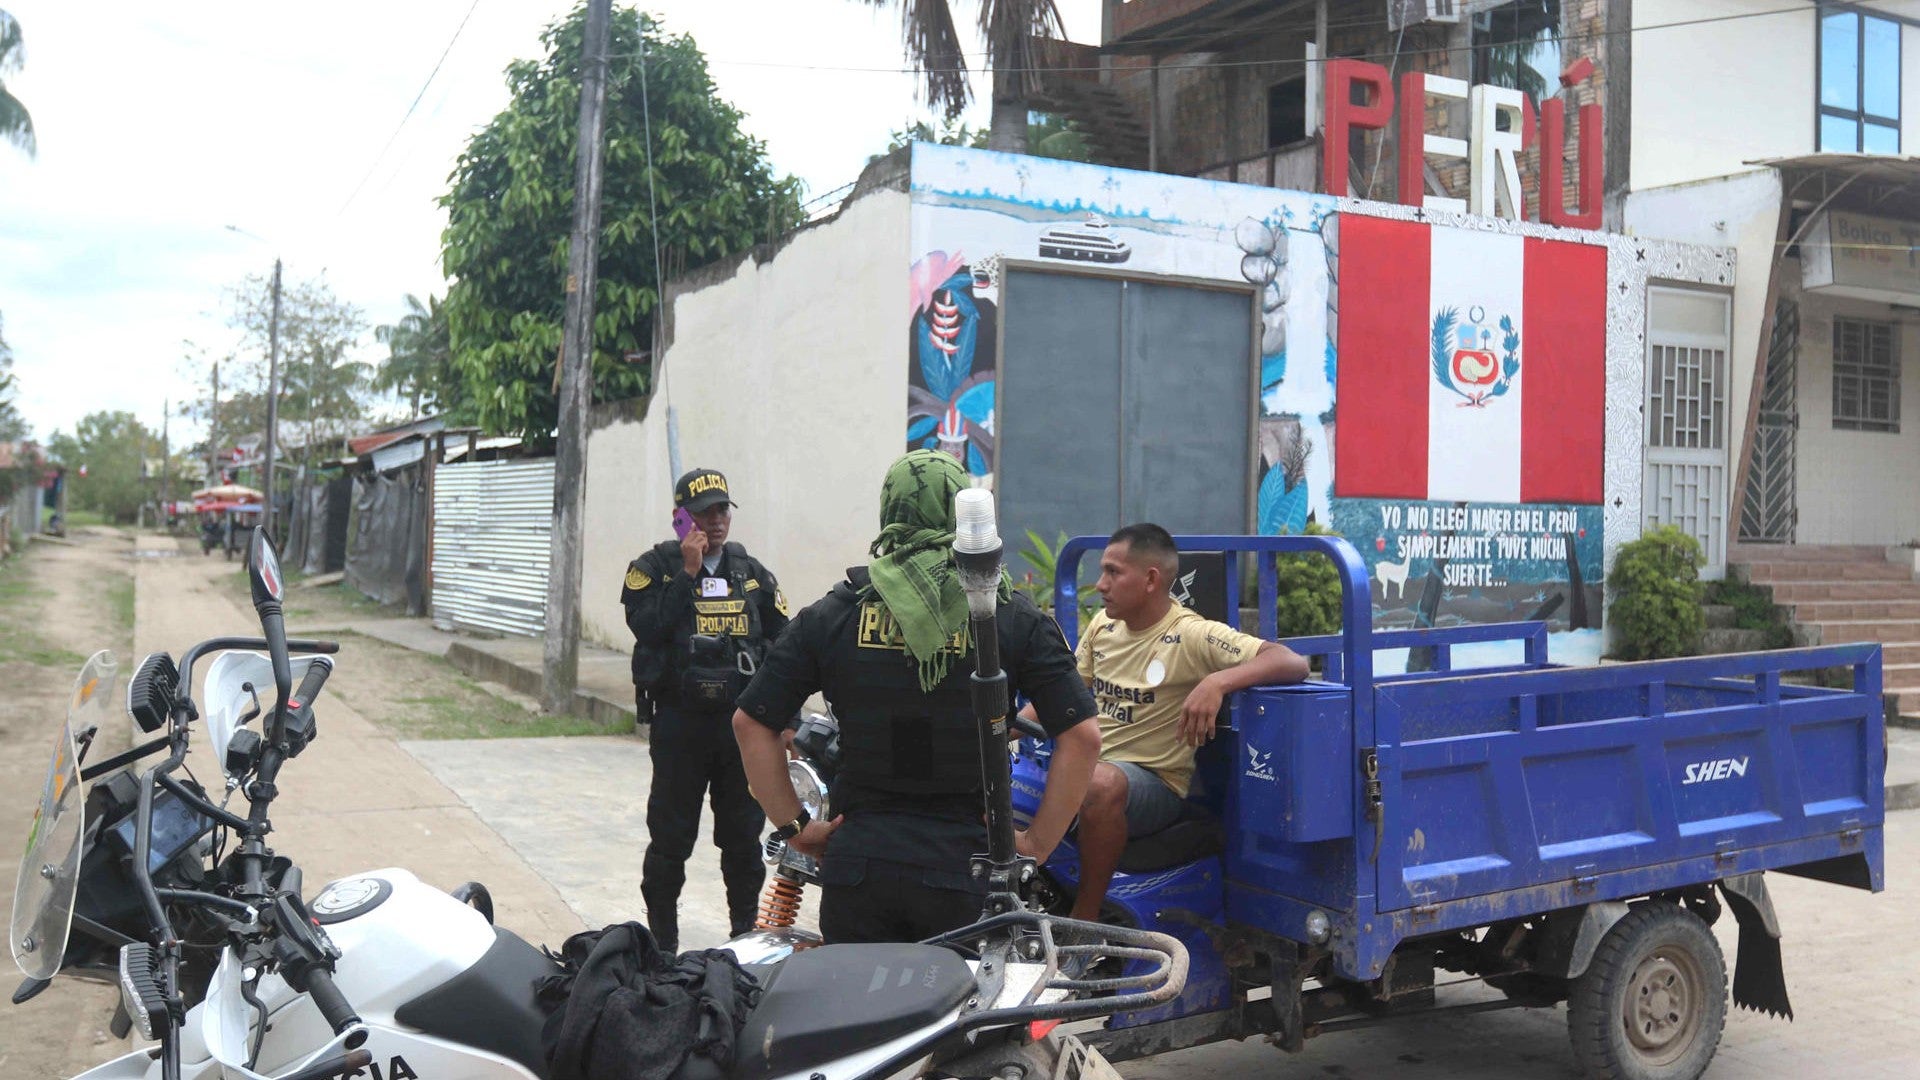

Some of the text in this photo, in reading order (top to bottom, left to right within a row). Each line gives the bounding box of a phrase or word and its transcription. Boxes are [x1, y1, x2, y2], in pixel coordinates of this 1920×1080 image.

[1323, 57, 1603, 231] PERÚ
[1381, 506, 1400, 530] YO
[1407, 506, 1429, 531] NO
[1514, 510, 1531, 532] EN
[1532, 510, 1546, 532] EL
[1548, 507, 1578, 533] PERÚ
[1397, 535, 1567, 561] SIMPLEMENTE TUVE MUCHA
[1093, 677, 1155, 704] puesta
[1682, 757, 1749, 784] SHEN
